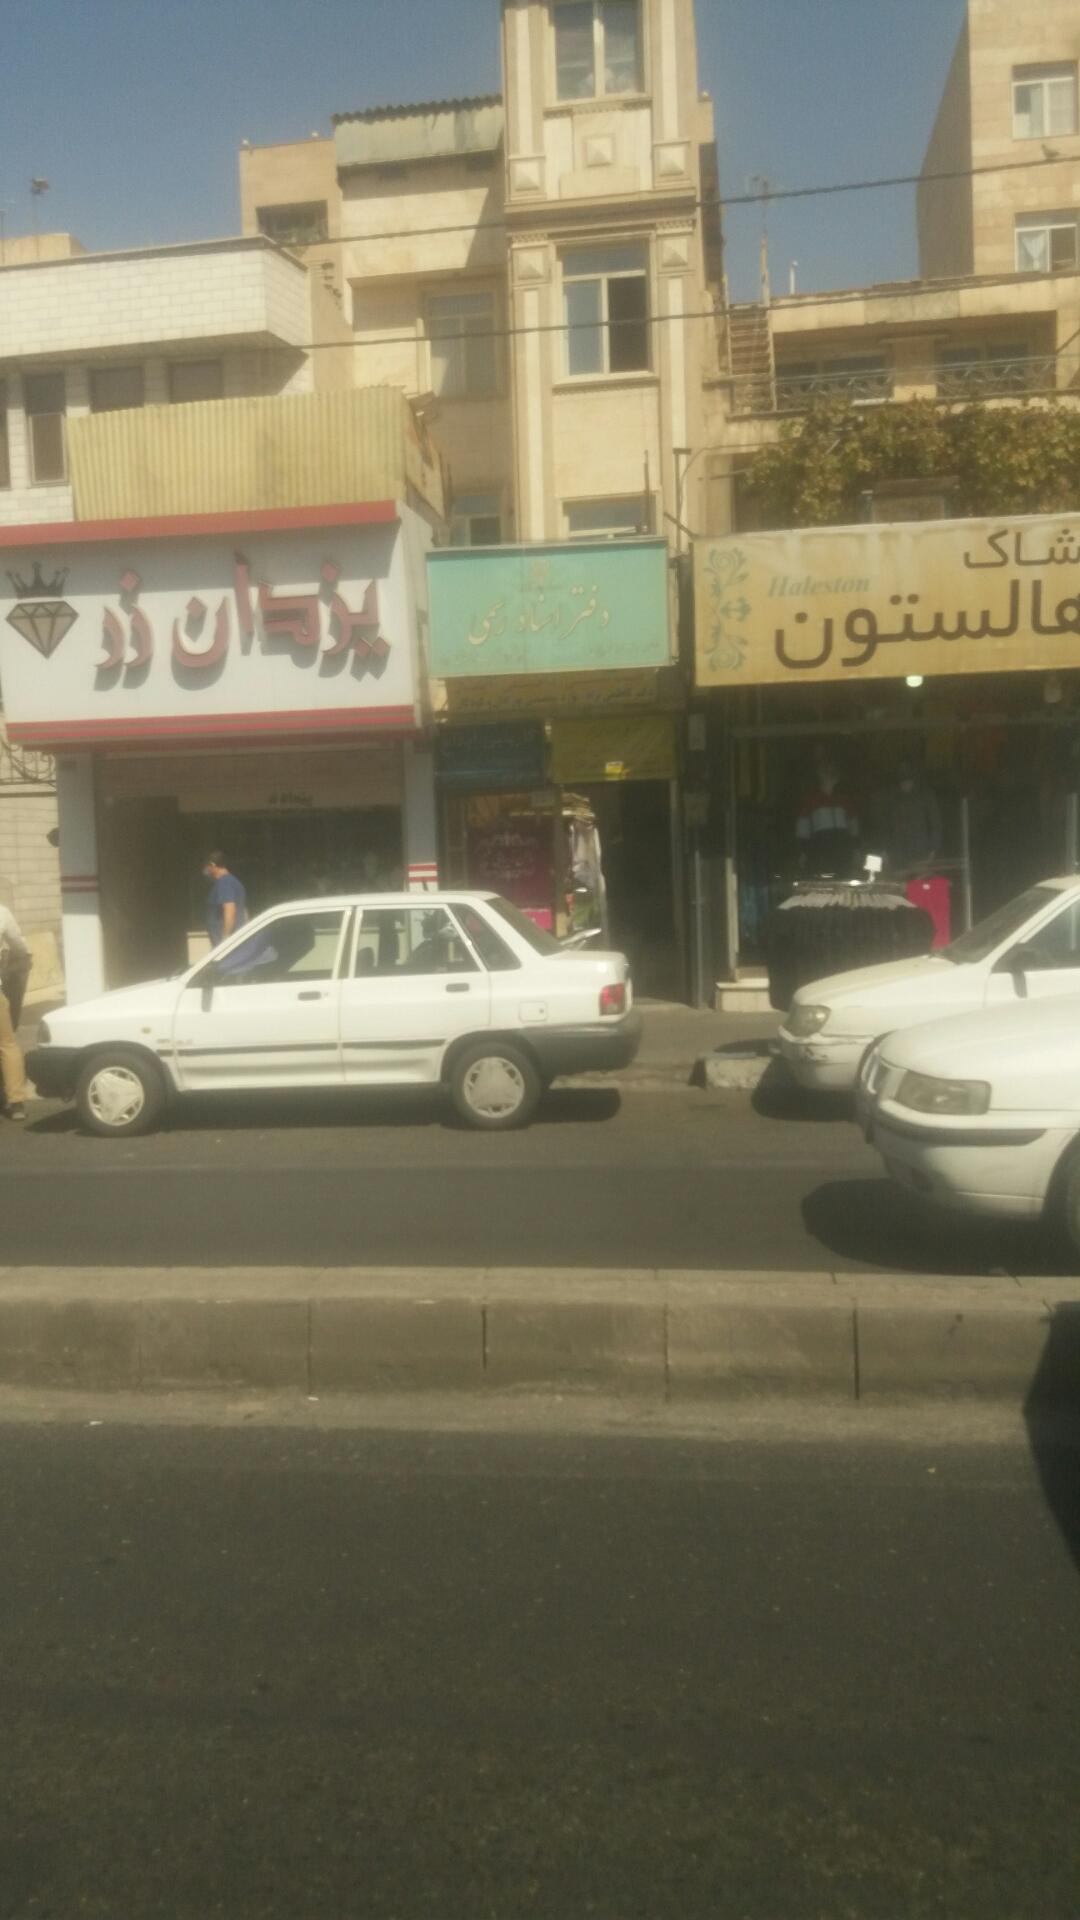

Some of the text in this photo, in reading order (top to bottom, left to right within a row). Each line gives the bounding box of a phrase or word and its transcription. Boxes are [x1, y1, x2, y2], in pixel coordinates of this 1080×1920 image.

[963, 528, 1080, 569] شاک
[94, 551, 391, 670] یزدان زر
[467, 583, 610, 646] دفتر اسناد رسمی
[767, 576, 870, 598] Haleston
[775, 579, 1080, 669] هالستون
